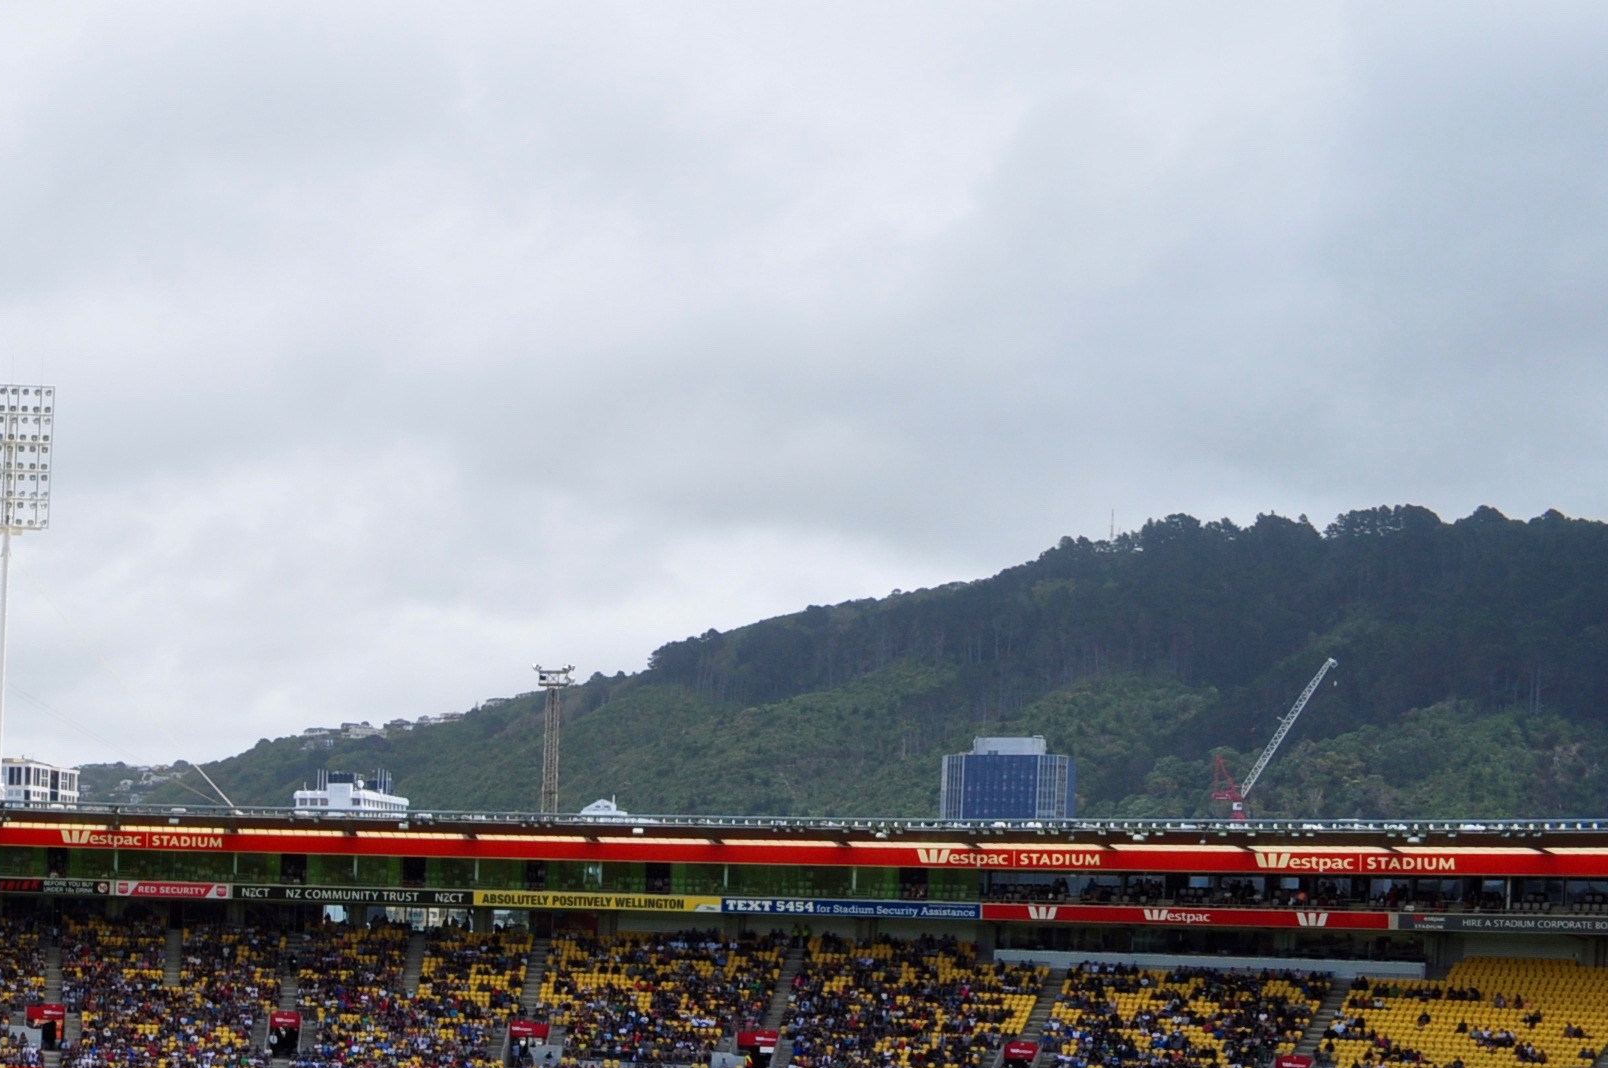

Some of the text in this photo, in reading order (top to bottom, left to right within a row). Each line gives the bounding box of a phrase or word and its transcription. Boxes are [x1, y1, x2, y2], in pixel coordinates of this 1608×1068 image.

[61, 829, 223, 848] Westpac STADIUM
[917, 849, 1101, 867] Westpac STADIUM
[1255, 852, 1456, 872] Westpac STADIUM
[138, 884, 206, 895] RED SECURITY
[242, 888, 270, 898] NZCT
[286, 888, 419, 901] NZ COMMUNITY TRUST
[435, 892, 464, 902] NZCT
[482, 894, 685, 909] ABSOLUTELY POSITIVELY WELLINGTON
[726, 899, 772, 911] TEXT
[776, 900, 814, 912] 5454
[816, 902, 830, 913] for
[833, 903, 874, 914] Stadium
[876, 904, 919, 917] Security
[920, 905, 975, 917] Assistance
[1143, 909, 1211, 923] Westpac
[1462, 919, 1482, 927] HIRE
[1484, 919, 1492, 927] A
[1493, 919, 1535, 928] STADIUM
[1537, 920, 1592, 929] CORPORATE
